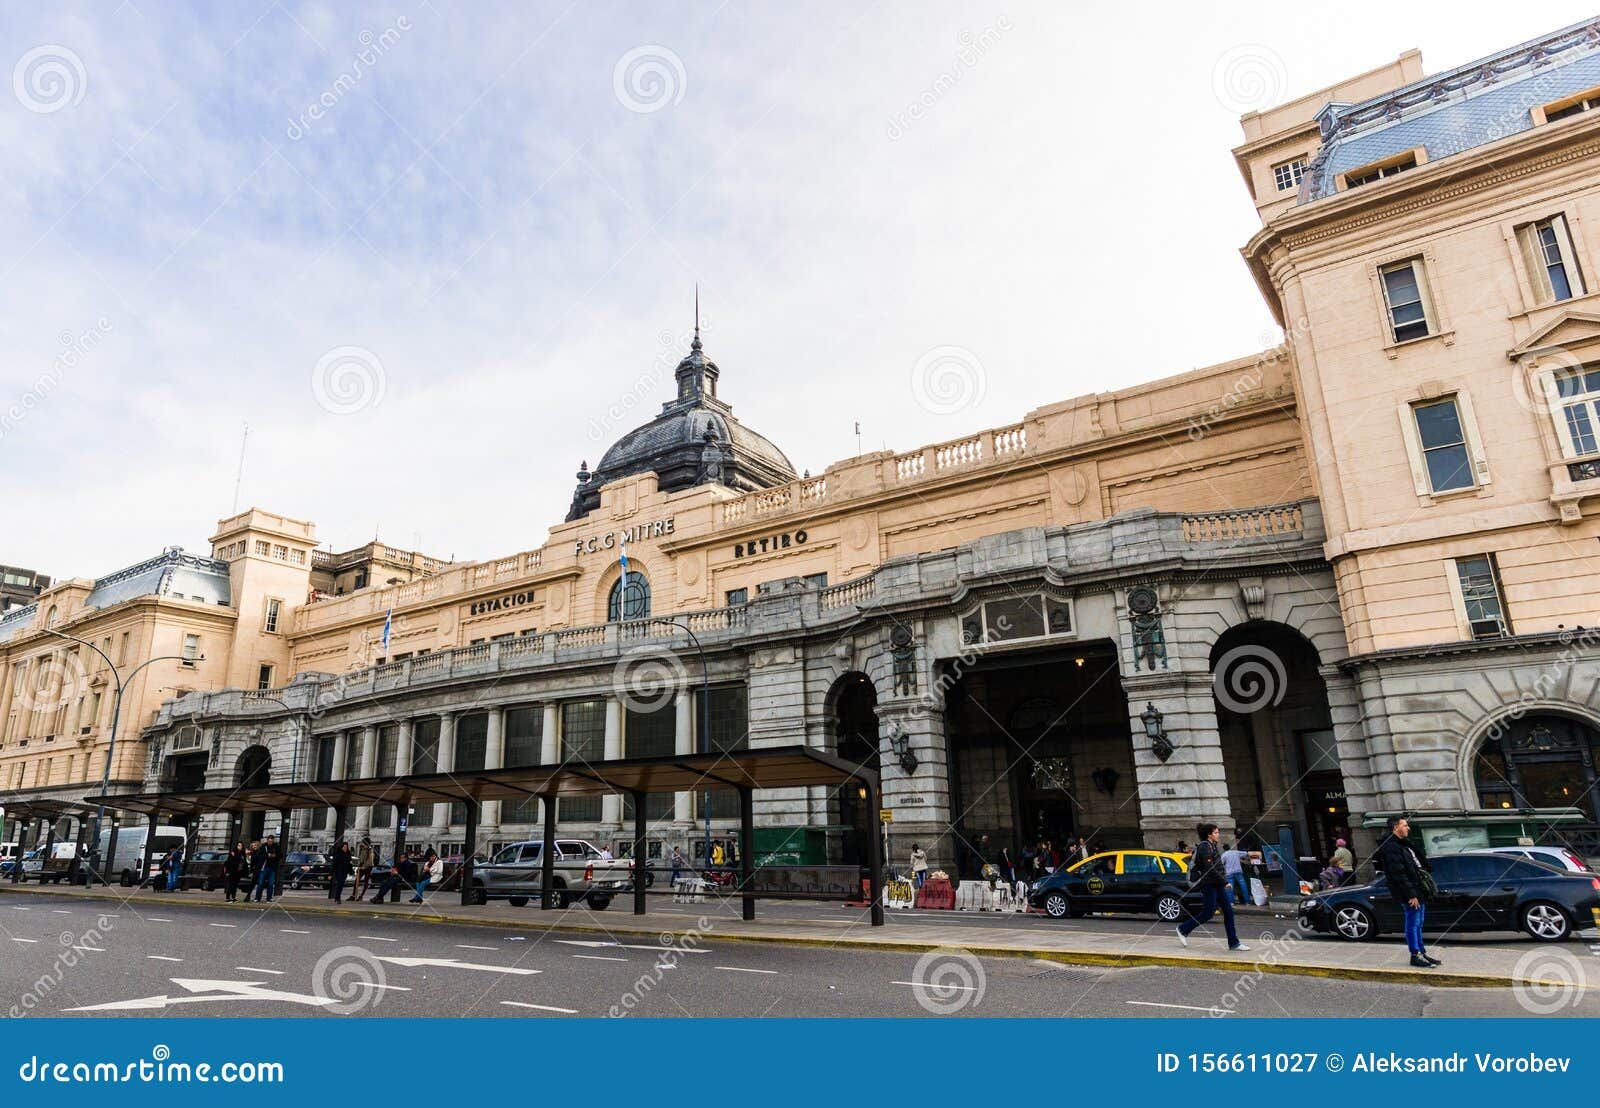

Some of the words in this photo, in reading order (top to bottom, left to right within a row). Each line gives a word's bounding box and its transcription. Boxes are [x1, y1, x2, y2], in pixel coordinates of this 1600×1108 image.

[620, 516, 675, 545] MITRE
[735, 529, 808, 559] RETIRO
[471, 591, 535, 616] ESTACION
